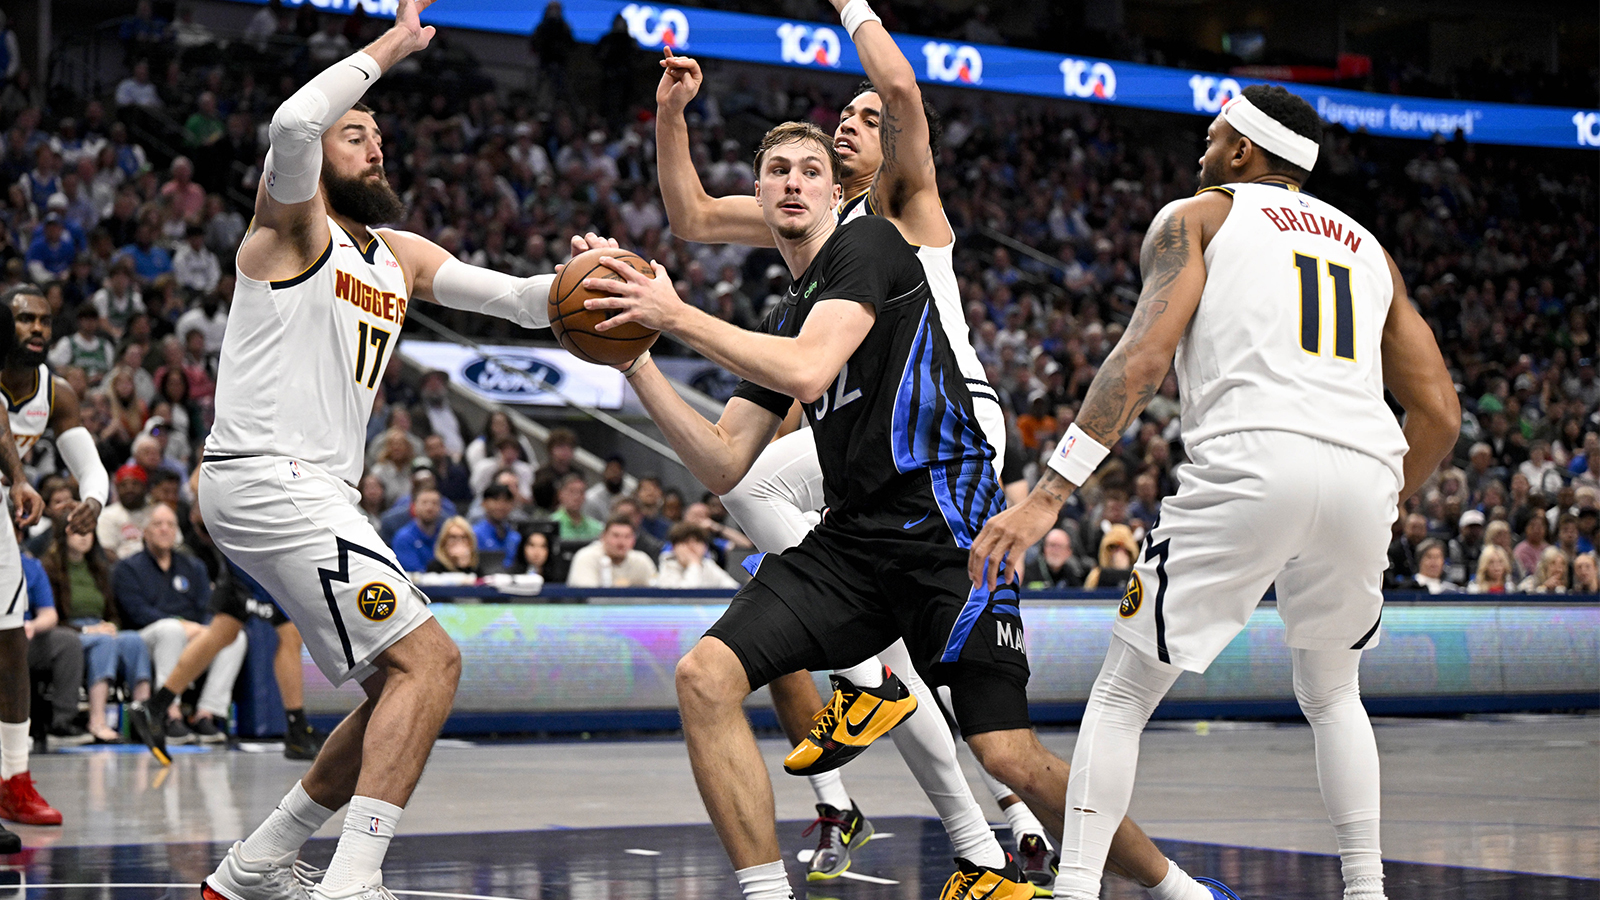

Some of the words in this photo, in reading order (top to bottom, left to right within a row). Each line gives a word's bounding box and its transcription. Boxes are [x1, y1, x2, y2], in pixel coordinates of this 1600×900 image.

[621, 3, 690, 50] 100
[776, 22, 841, 68] 100
[921, 41, 983, 85] 100
[1059, 58, 1117, 101] 100
[1261, 207, 1362, 253] BROWN
[335, 268, 406, 327] NUGGETS
[1292, 249, 1357, 363] 11
[355, 319, 391, 390] 17
[477, 356, 549, 393] Ford
